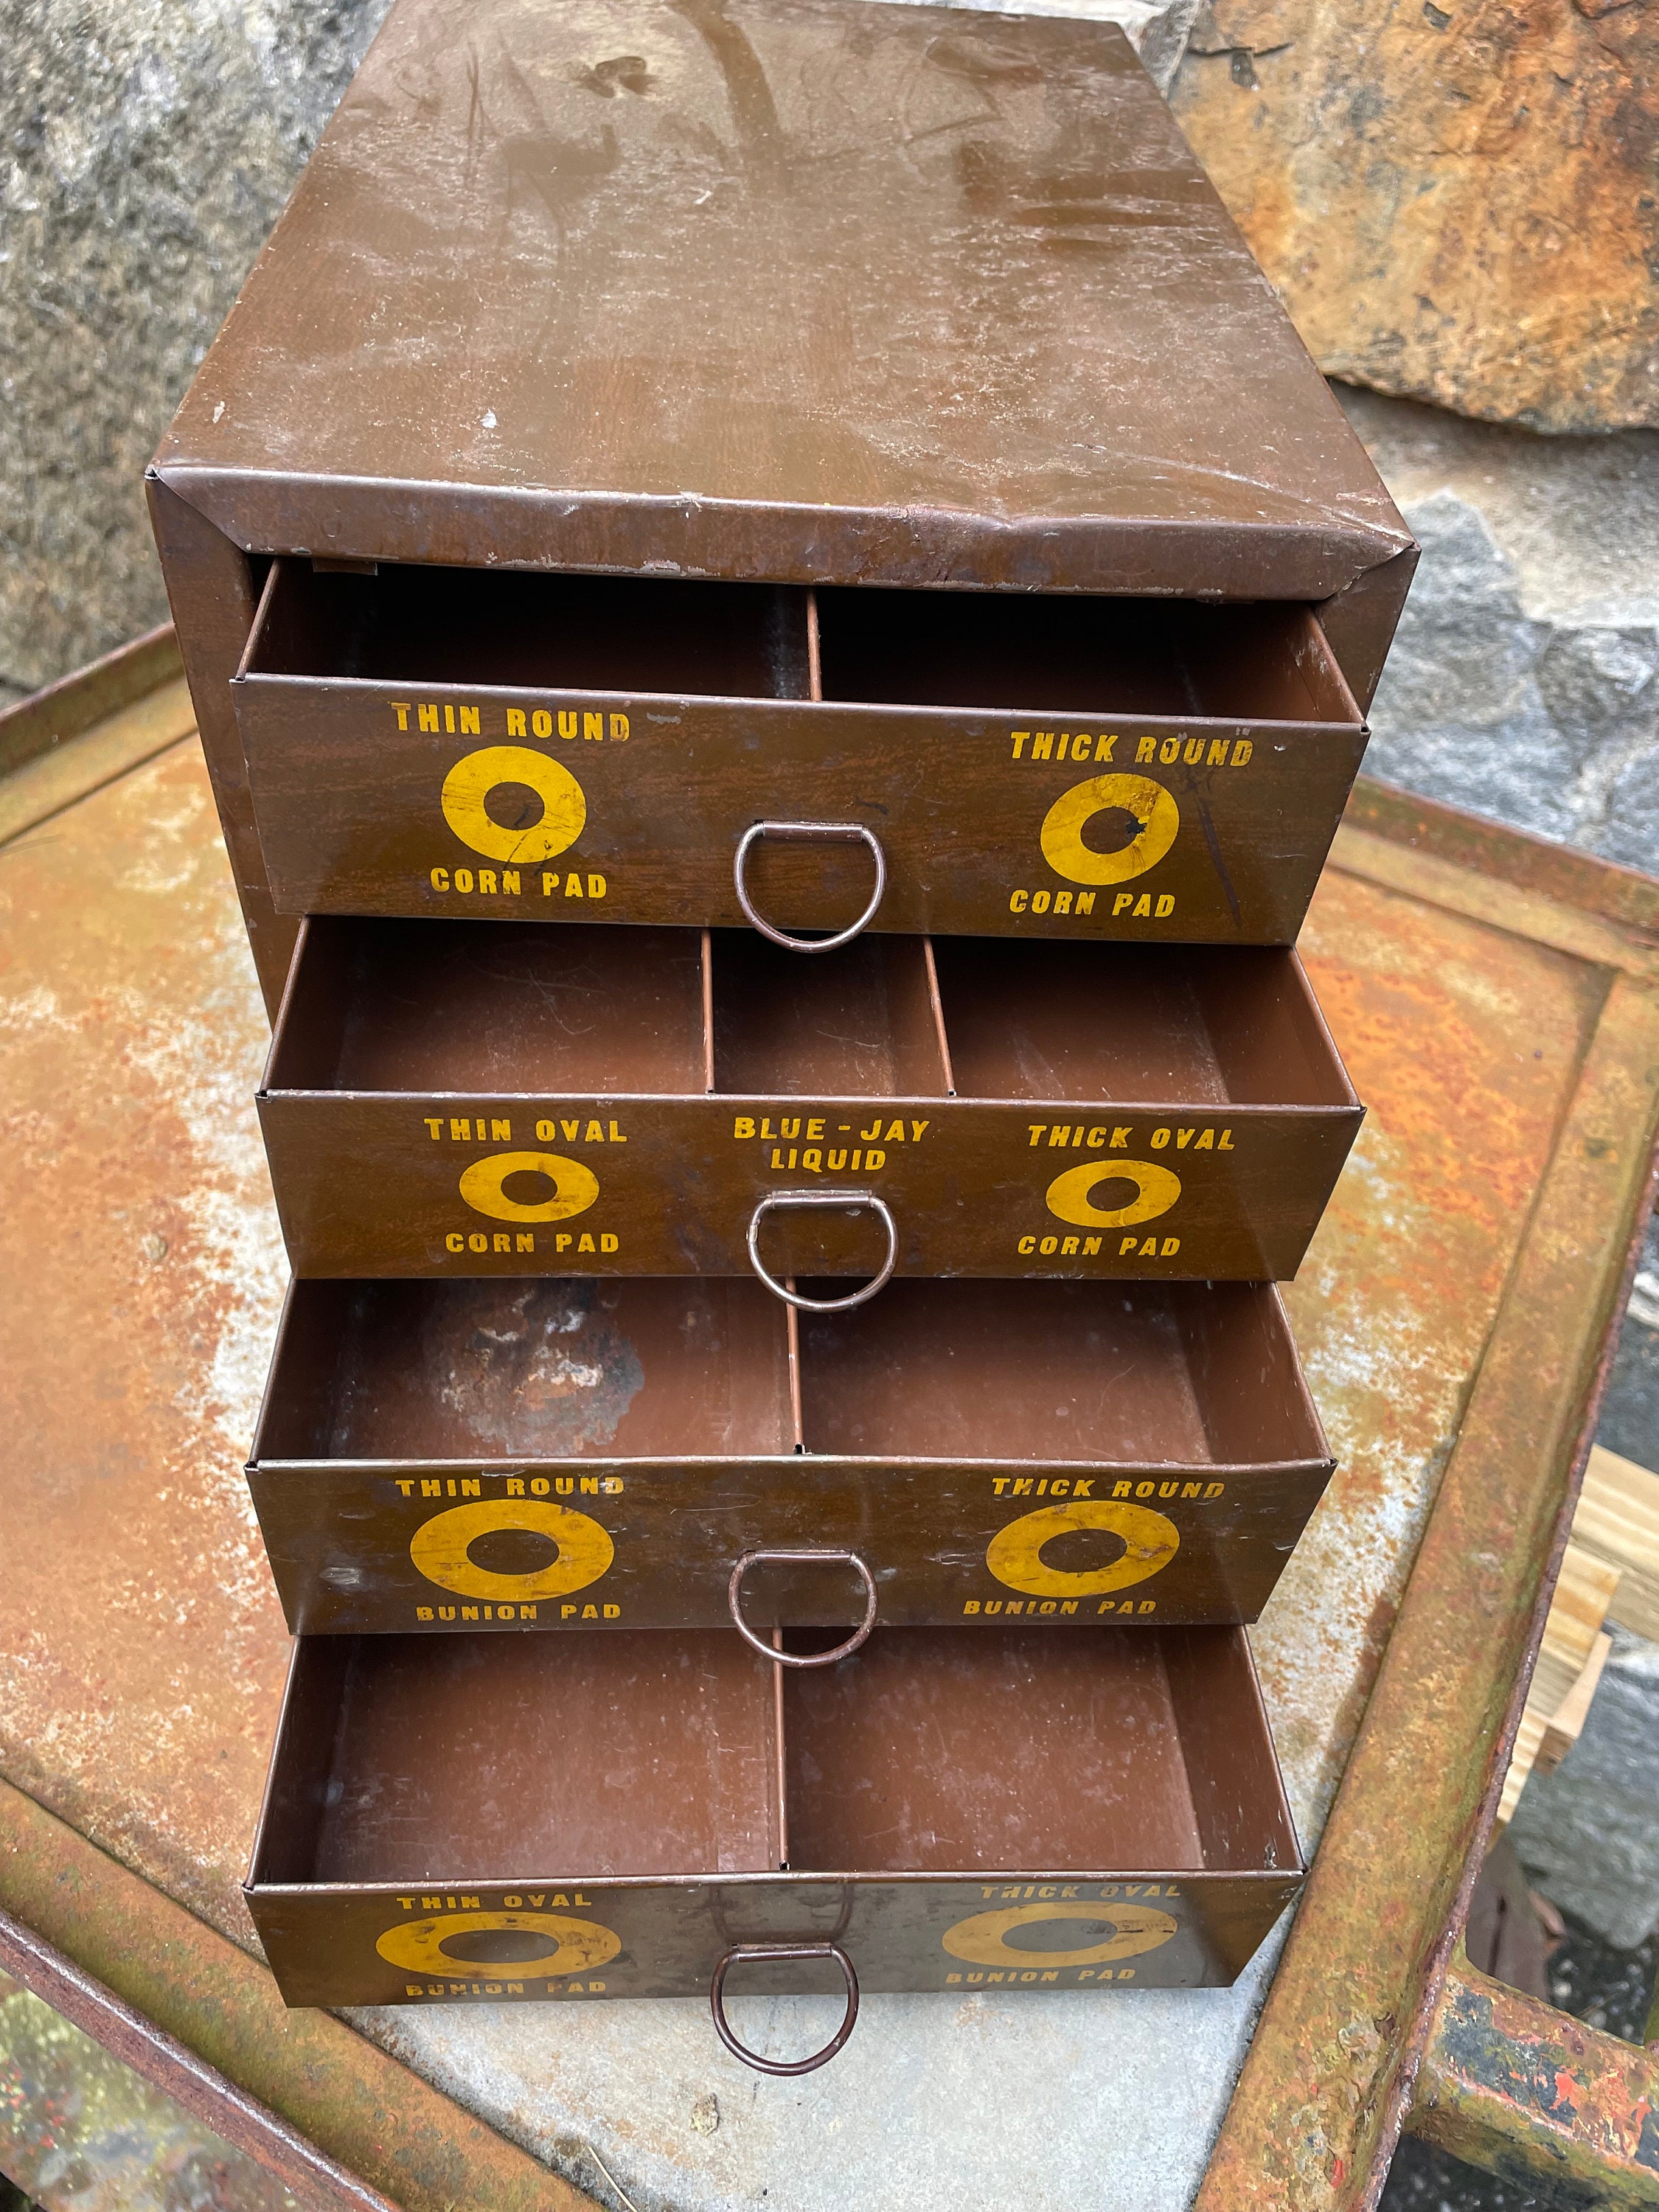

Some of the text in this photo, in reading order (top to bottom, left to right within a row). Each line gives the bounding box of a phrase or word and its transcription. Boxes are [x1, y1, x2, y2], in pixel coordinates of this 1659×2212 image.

[391, 702, 630, 742] THIN ROUND
[1010, 731, 1253, 767] THICK ROUND
[430, 867, 607, 899] CORN PAD
[1009, 889, 1175, 918] CORN PAD
[423, 1118, 627, 1142] THIN OVAL
[1028, 1124, 1235, 1150] THICK OVAL
[771, 1148, 886, 1173] LIQUID
[445, 1233, 619, 1253] CORN PAD
[1018, 1235, 1180, 1256] CORN PAD
[394, 1476, 625, 1498] THIN ROUND
[992, 1478, 1225, 1498] THICK ROUND
[416, 1604, 621, 1621] BUNION PAD
[963, 1600, 1156, 1615] BUNION PAD
[396, 1893, 592, 1910] THIN OVAL
[981, 1885, 1180, 1899] THICK OVAL
[946, 1969, 1136, 1984] BUNION PAD
[406, 1981, 606, 1997] BUNION PAD
